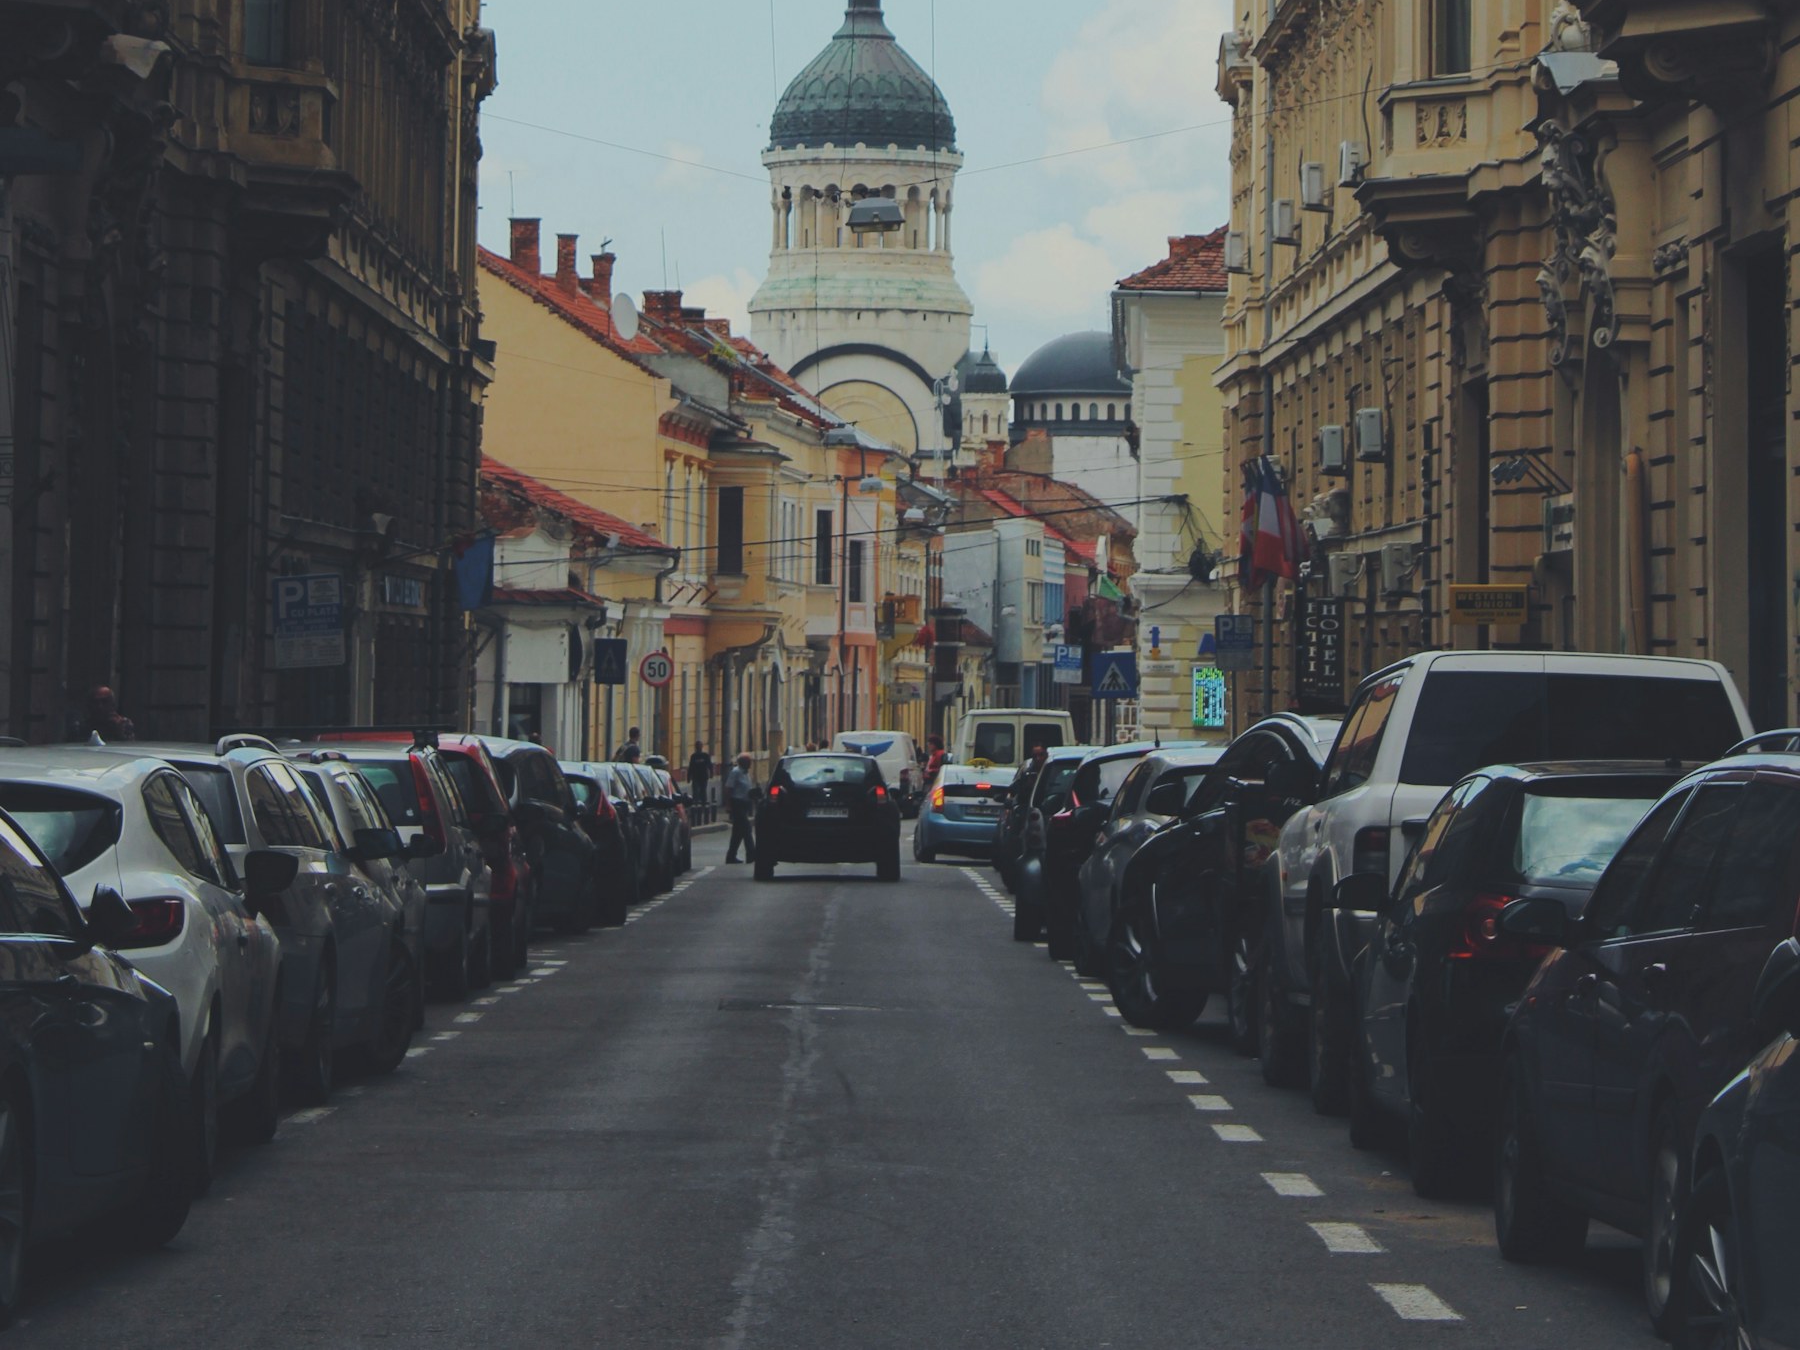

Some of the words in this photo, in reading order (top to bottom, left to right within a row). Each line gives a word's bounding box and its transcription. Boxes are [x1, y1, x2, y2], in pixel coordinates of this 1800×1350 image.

[279, 581, 305, 619] P
[291, 609, 305, 618] CU
[1219, 618, 1233, 641] P
[1320, 604, 1339, 676] HOTEL
[1057, 646, 1068, 662] P
[648, 662, 667, 677] 50
